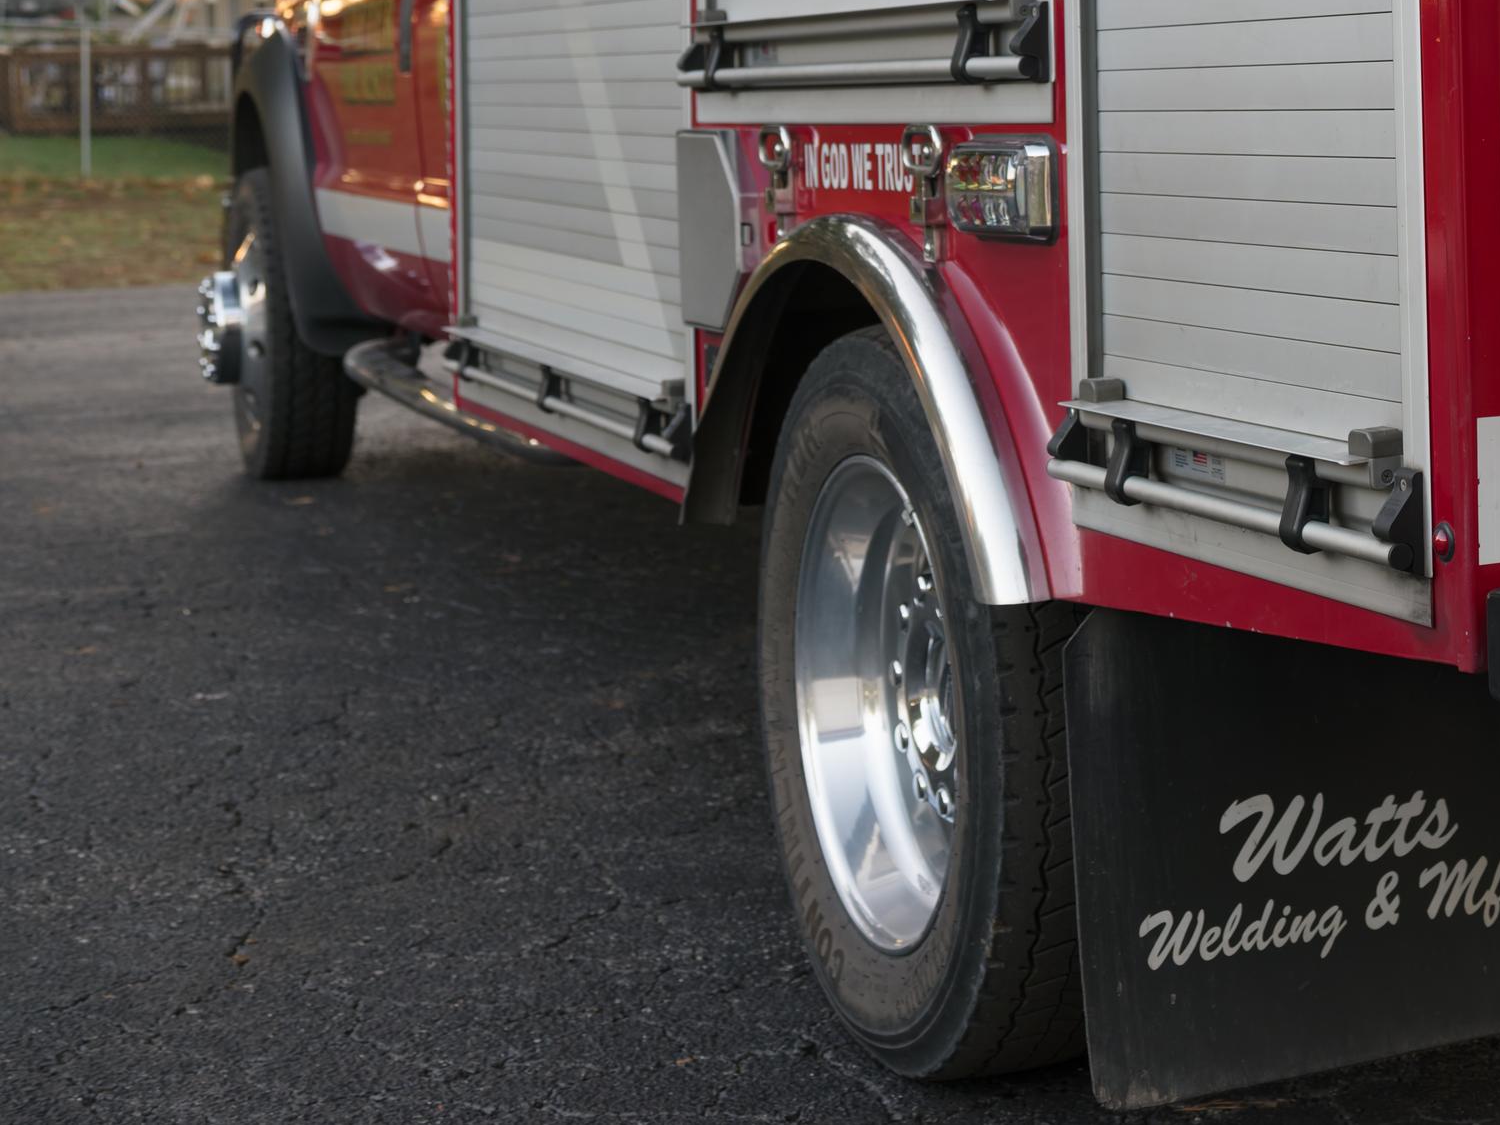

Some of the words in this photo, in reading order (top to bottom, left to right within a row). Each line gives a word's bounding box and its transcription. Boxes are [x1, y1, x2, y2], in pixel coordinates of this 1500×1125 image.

[804, 143, 819, 189] IN
[821, 143, 849, 190] GOD
[850, 143, 873, 191] WE
[1219, 789, 1459, 883] Watts
[1138, 898, 1348, 971] Welding
[1364, 870, 1401, 931] &
